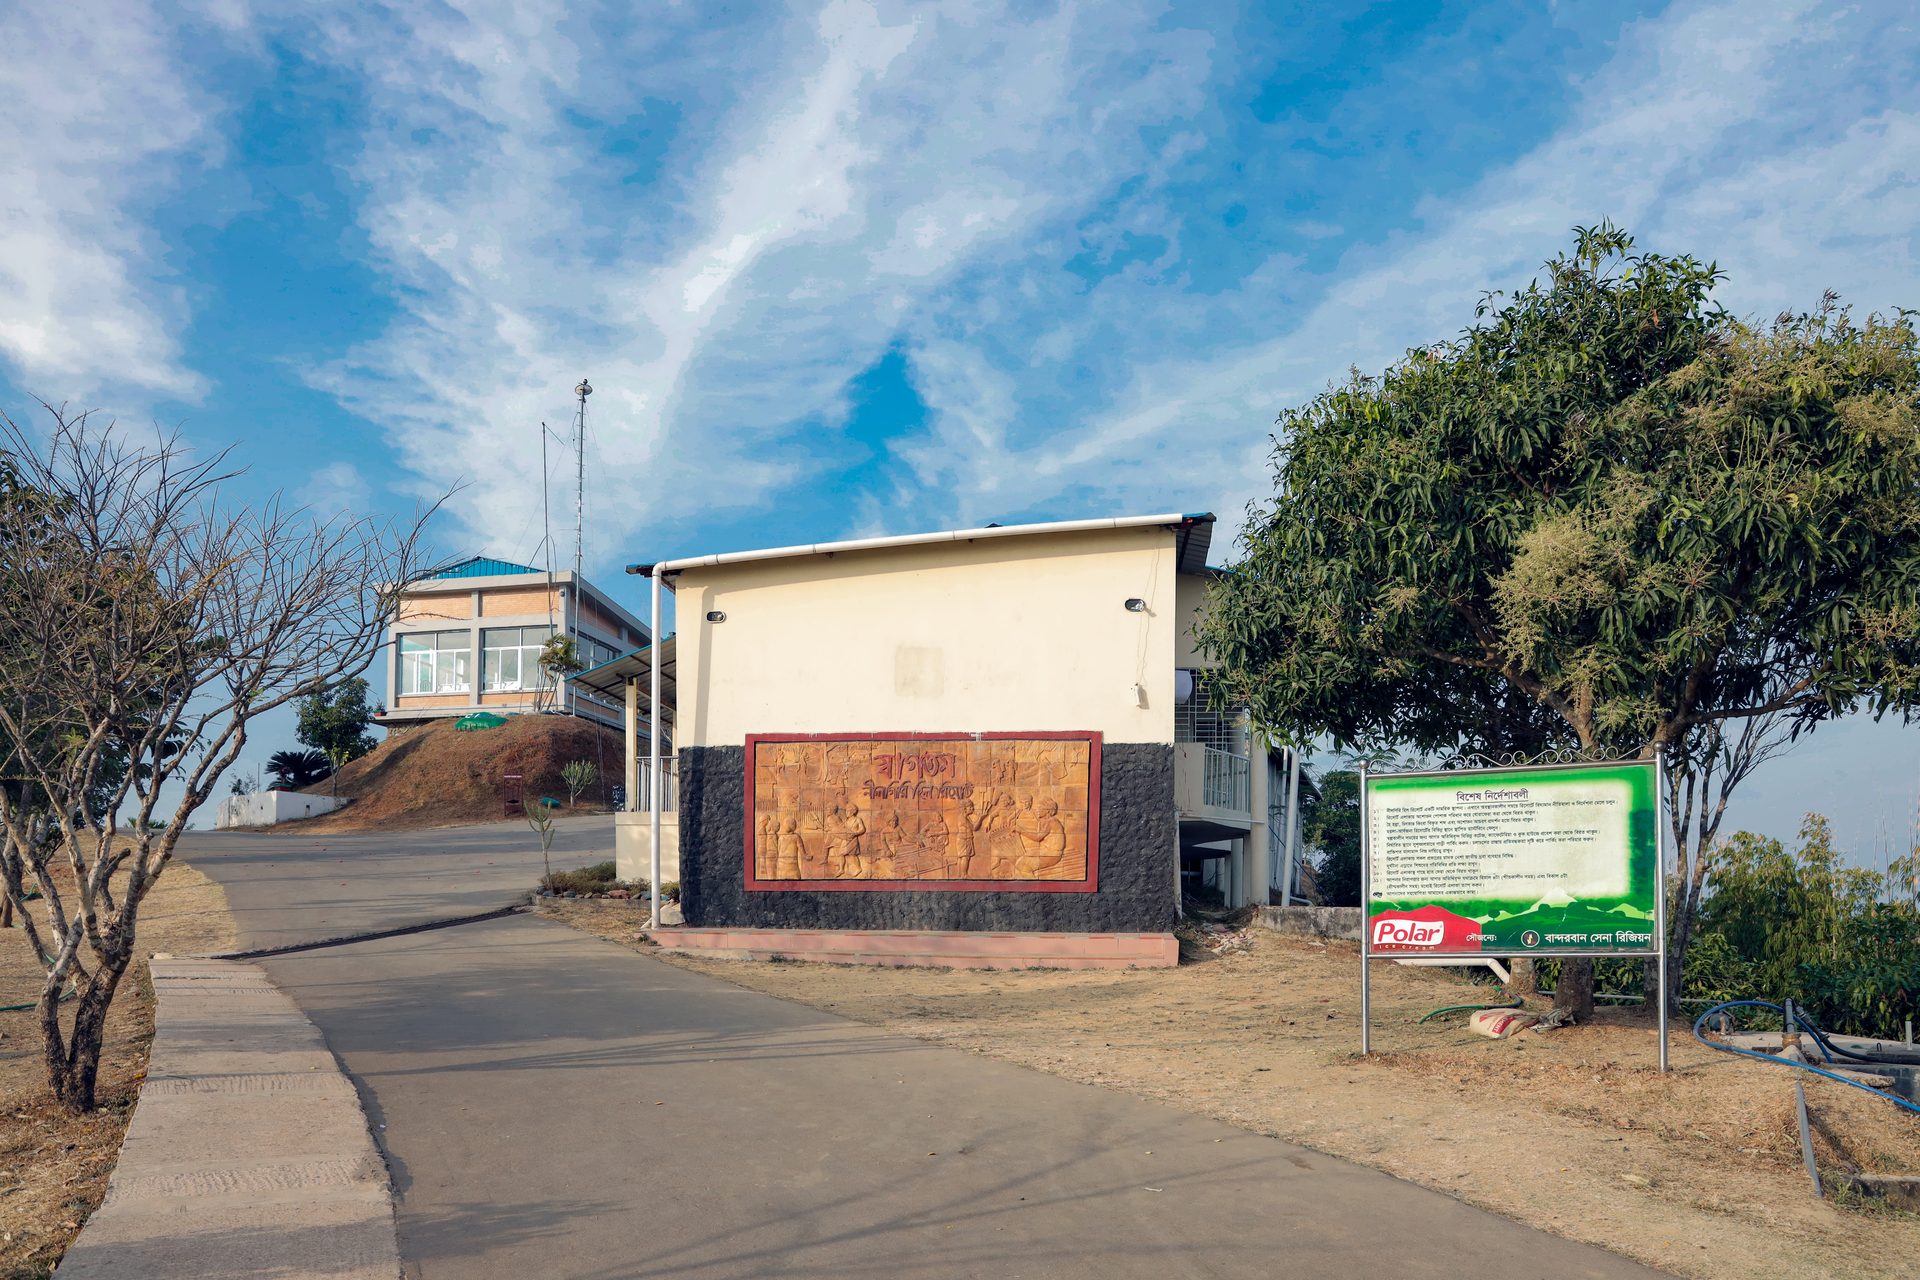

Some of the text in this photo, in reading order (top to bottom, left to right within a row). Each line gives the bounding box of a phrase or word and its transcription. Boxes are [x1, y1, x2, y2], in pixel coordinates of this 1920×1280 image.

[873, 751, 956, 780] স্বাগতম
[1456, 787, 1529, 802] বিশেষ নির্দেশাবলী
[1378, 922, 1441, 942] Polar
[1544, 930, 1652, 943] বান্দরবান সেনা রিজিয়ন
